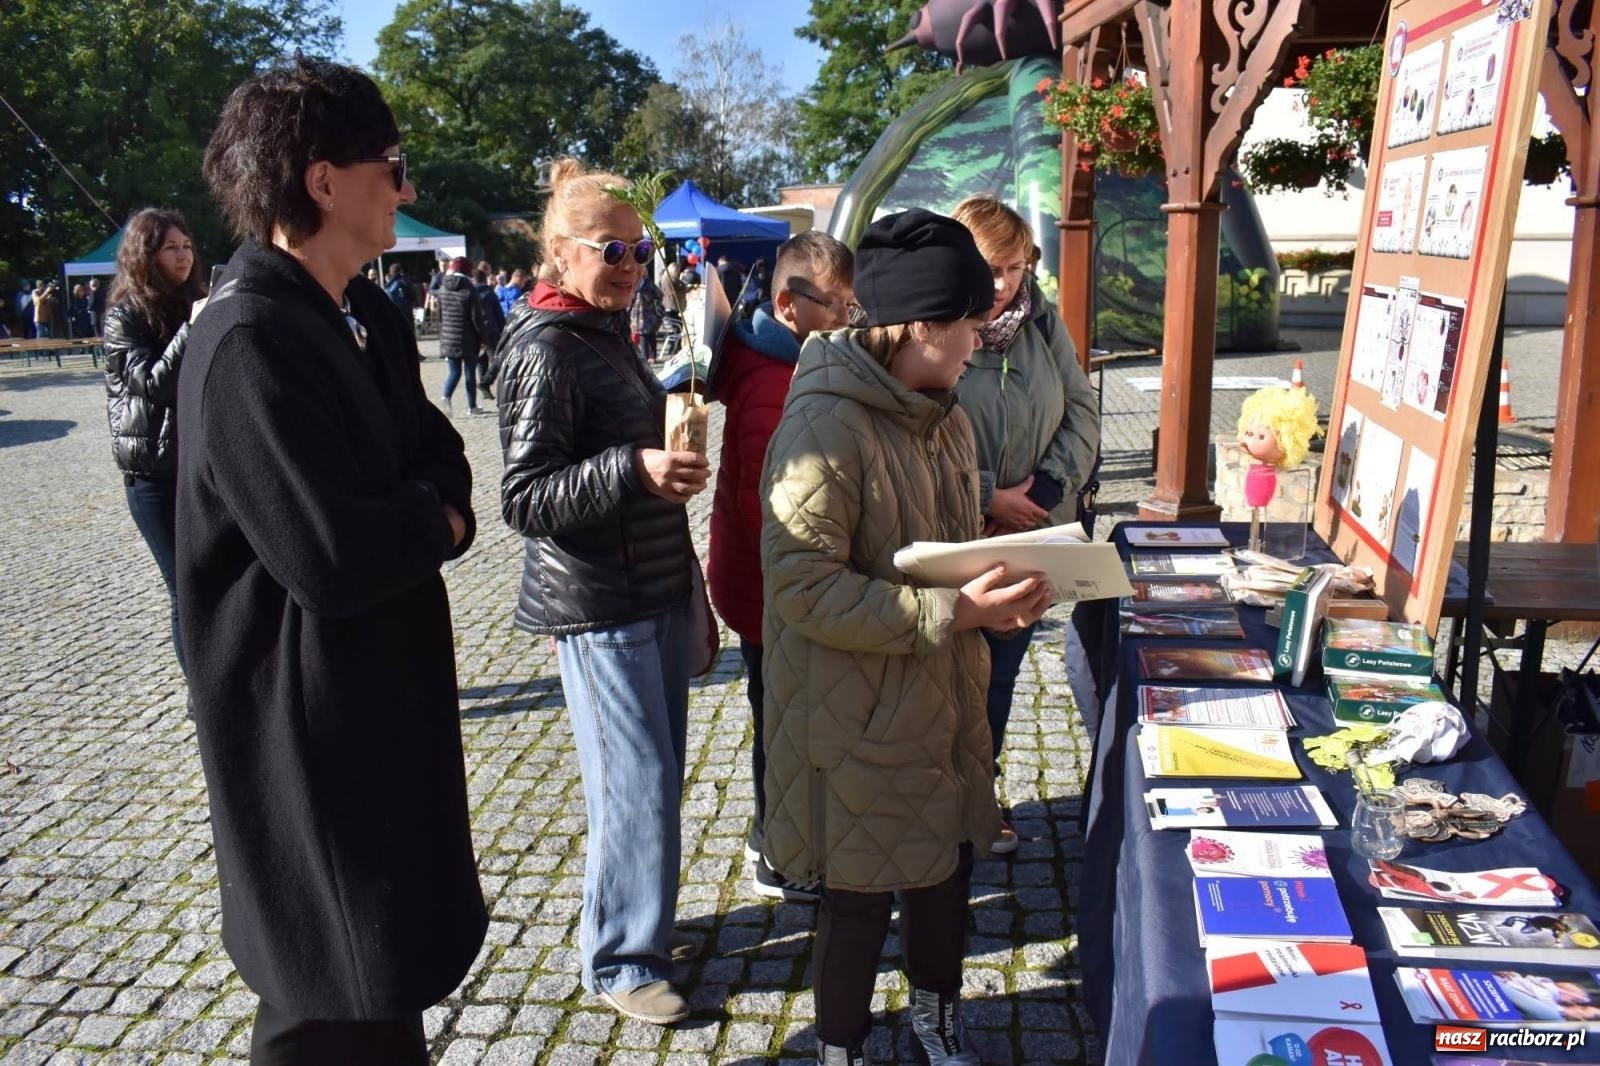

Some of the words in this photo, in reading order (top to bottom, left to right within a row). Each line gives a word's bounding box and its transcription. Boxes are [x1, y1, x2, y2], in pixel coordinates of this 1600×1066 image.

[1283, 640, 1292, 652] Lasy
[1362, 658, 1377, 666] Lasy
[1378, 659, 1413, 668] Państwowe
[1377, 709, 1392, 717] Lasy
[1276, 887, 1298, 923] potrzebuję
[1264, 949, 1287, 977] rodzinne
